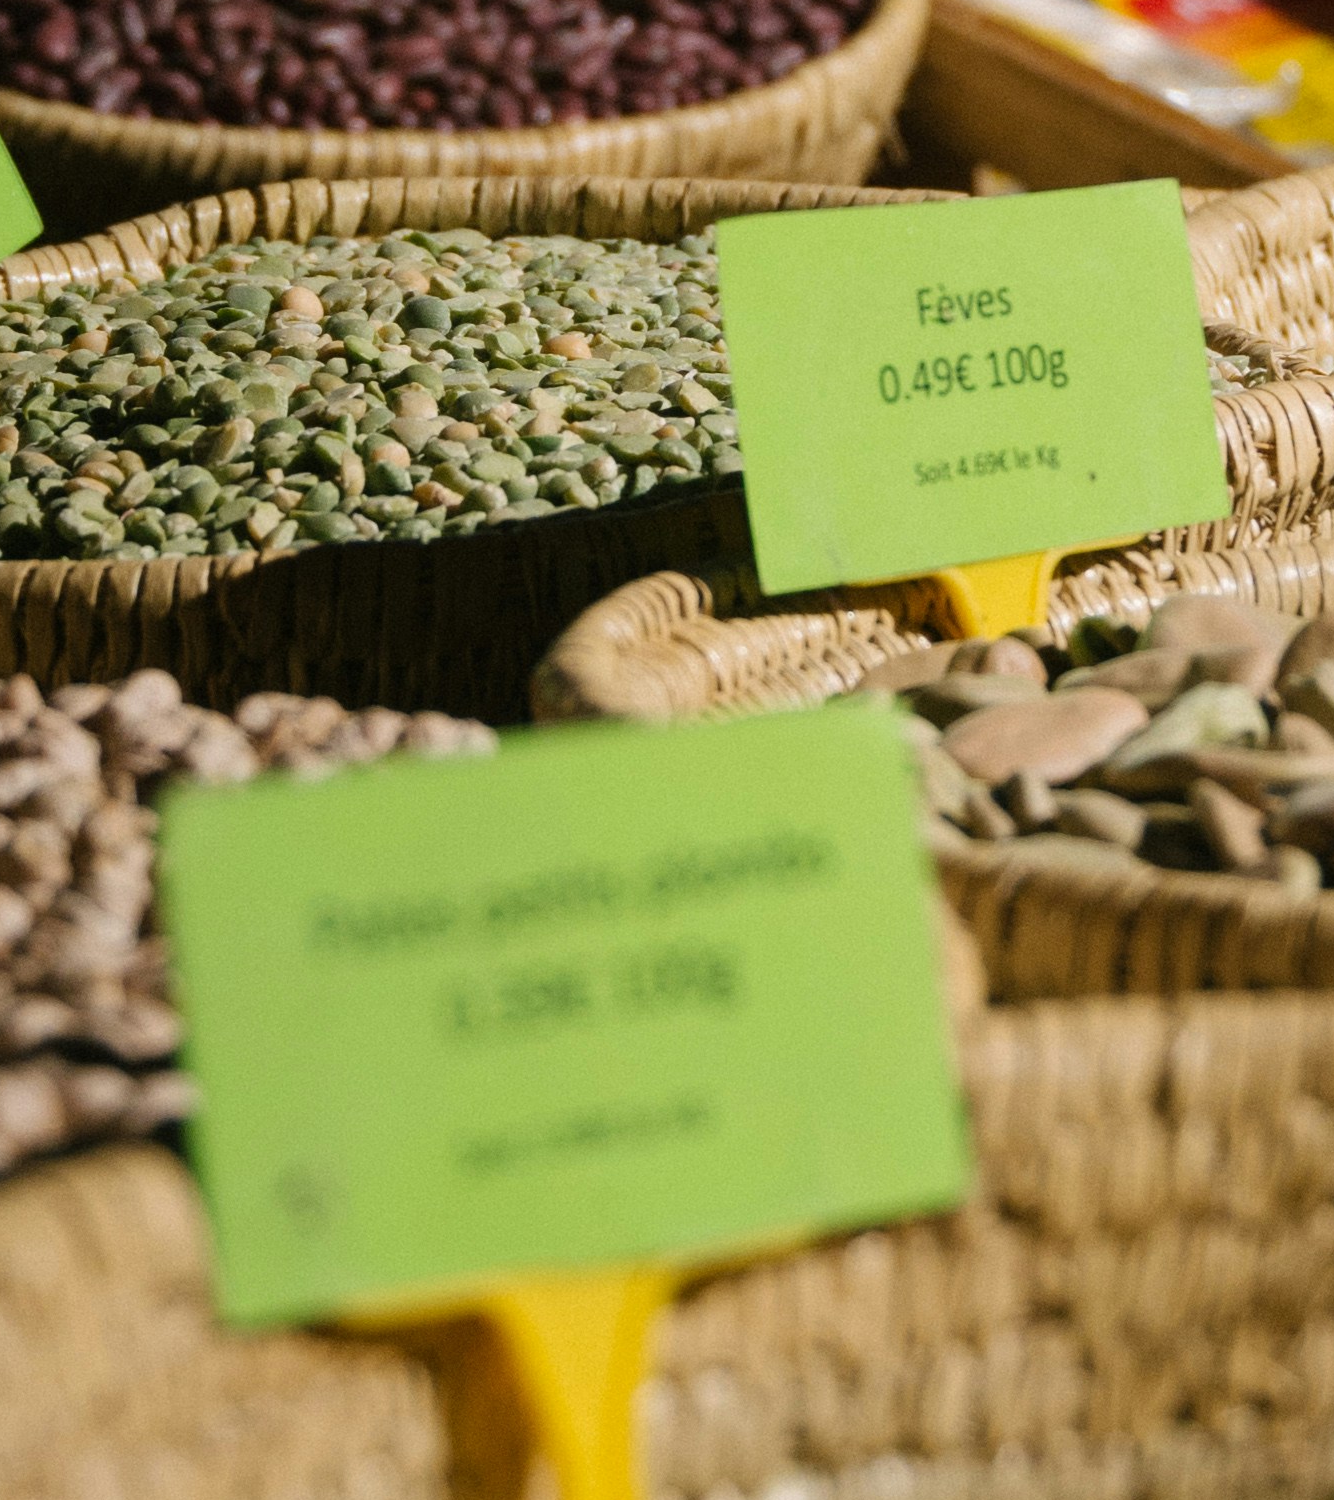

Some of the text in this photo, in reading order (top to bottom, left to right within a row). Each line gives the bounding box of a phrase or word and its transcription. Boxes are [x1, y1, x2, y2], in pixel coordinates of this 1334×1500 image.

[879, 343, 1069, 403] 0.49€ 100g
[914, 459, 953, 486] Soit
[1013, 448, 1032, 468] le
[1037, 444, 1060, 470] Kg
